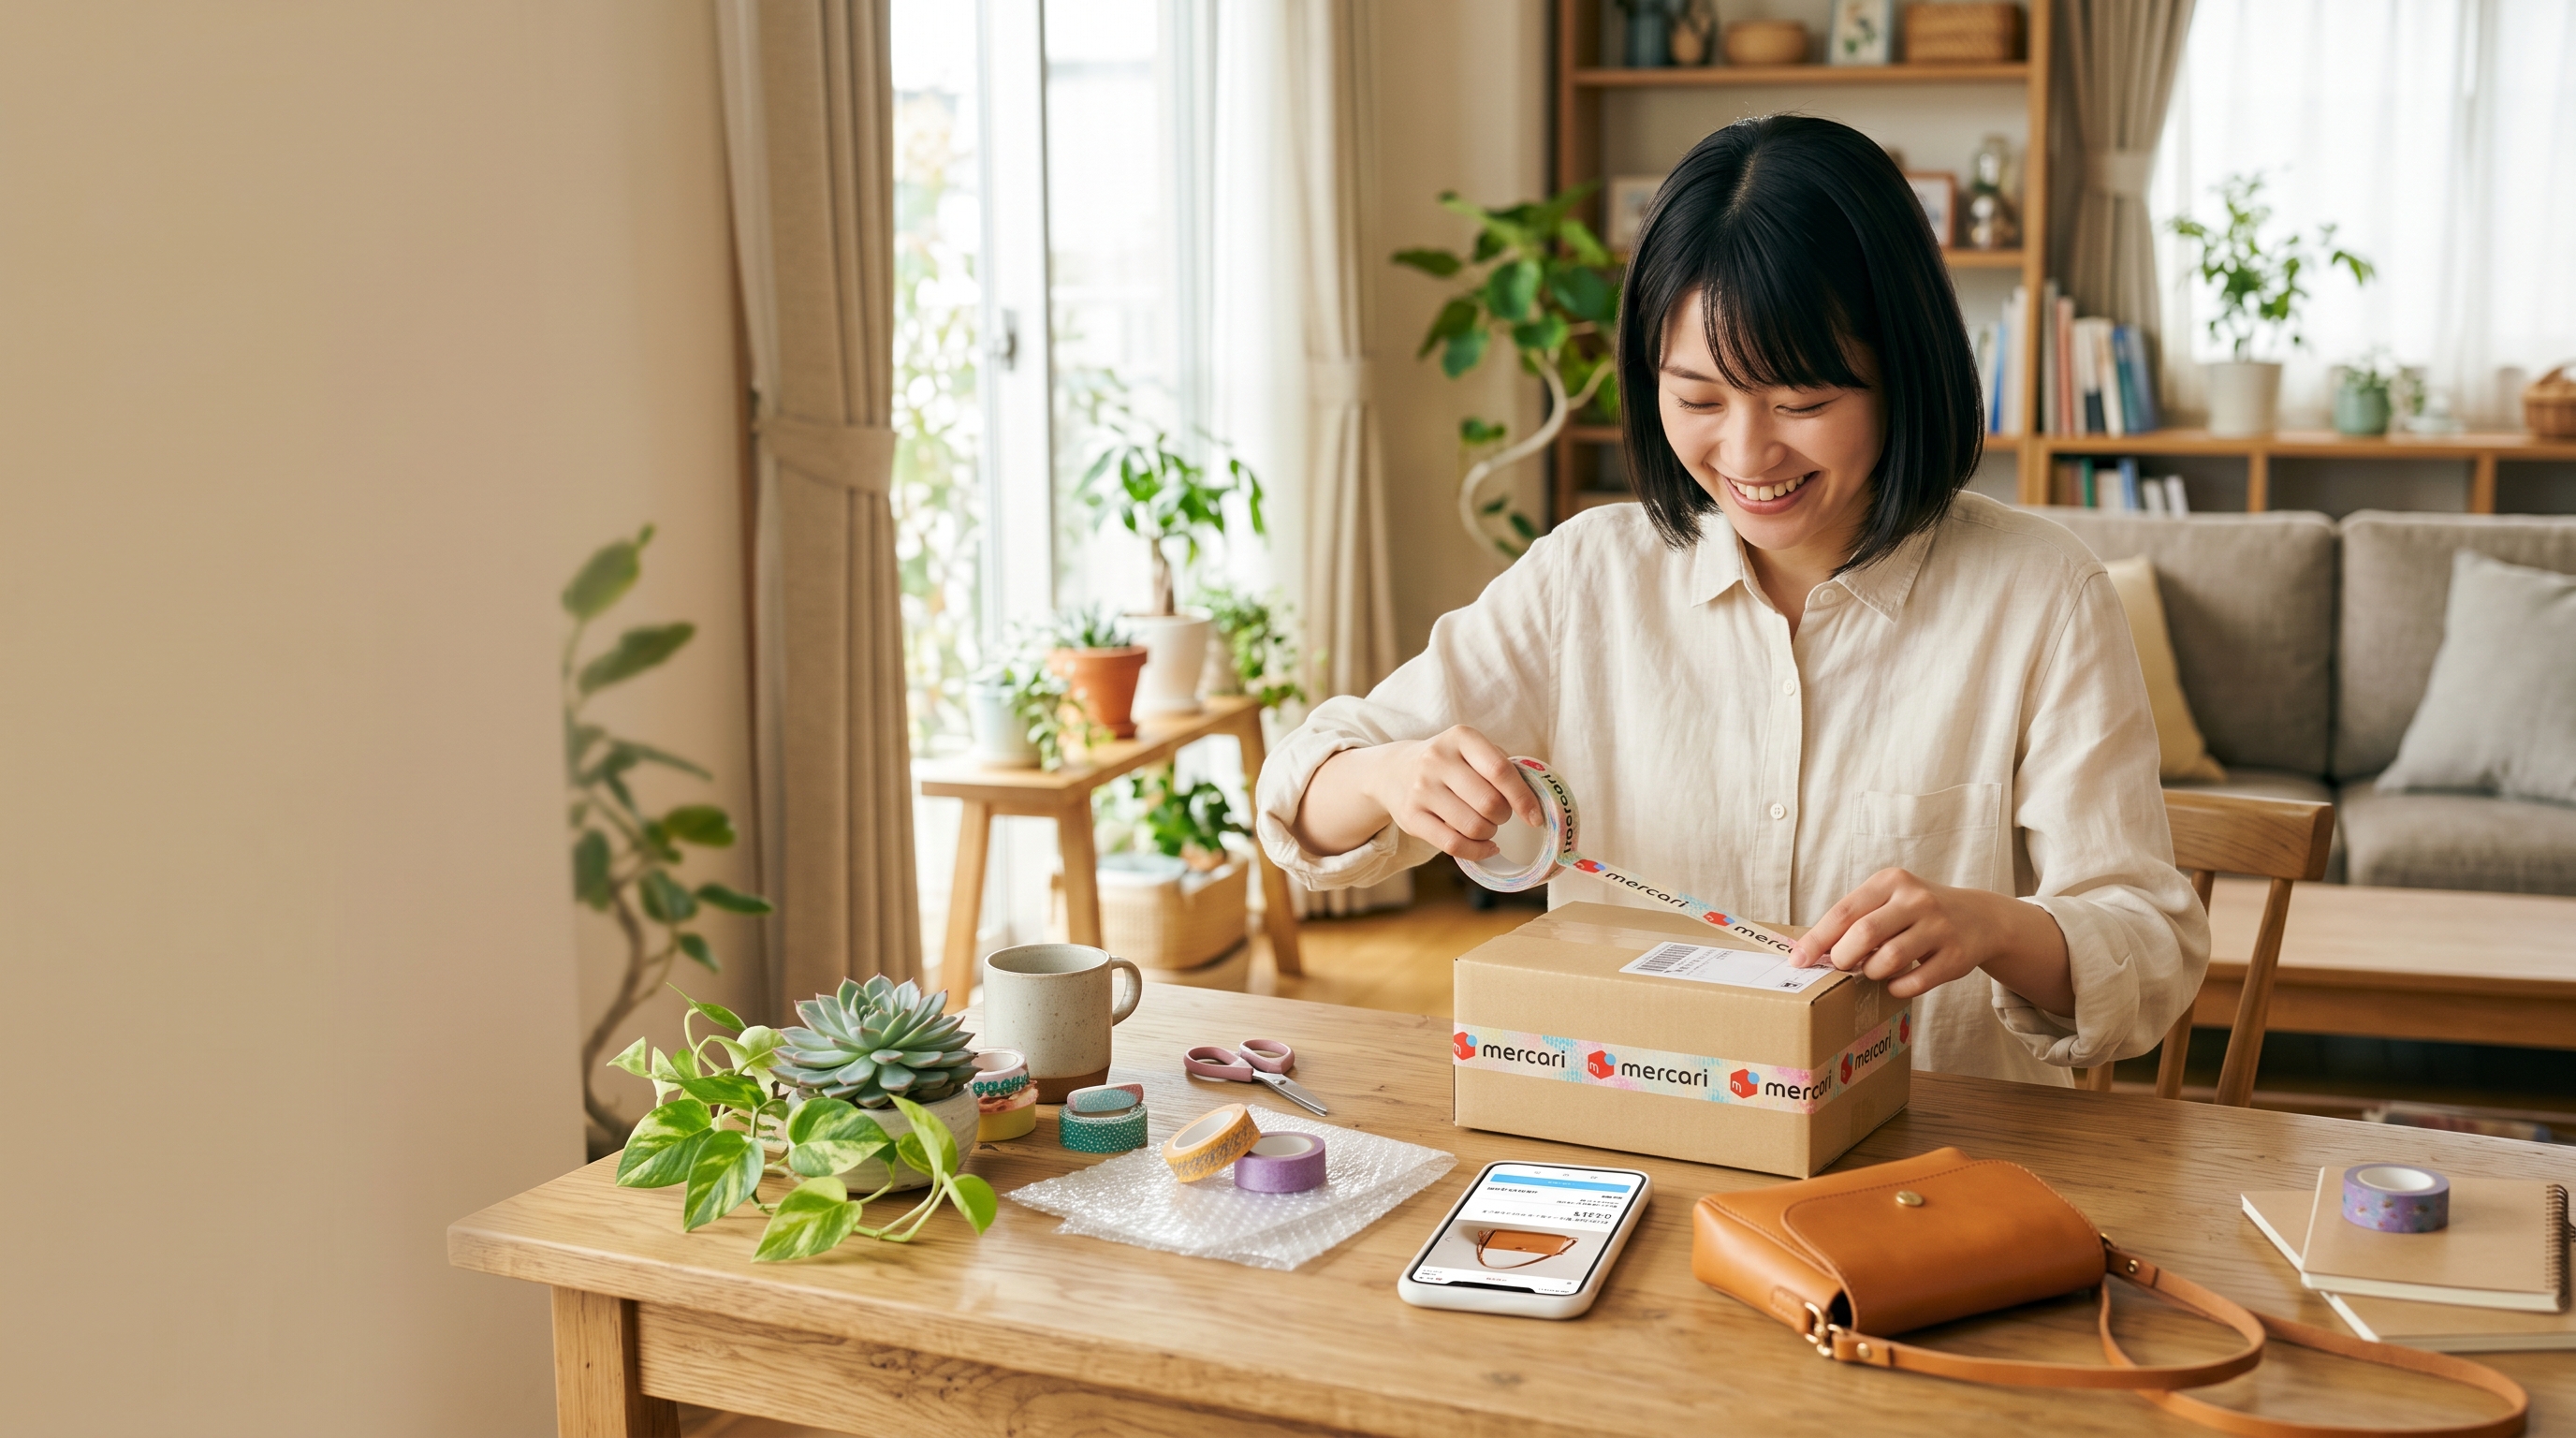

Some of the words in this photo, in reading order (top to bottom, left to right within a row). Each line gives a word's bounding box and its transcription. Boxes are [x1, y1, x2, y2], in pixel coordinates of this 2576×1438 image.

[1605, 873, 1690, 908] mercari
[1734, 926, 1793, 955] merc
[1483, 1044, 1565, 1068] mercari
[1621, 1063, 1708, 1088] mercari
